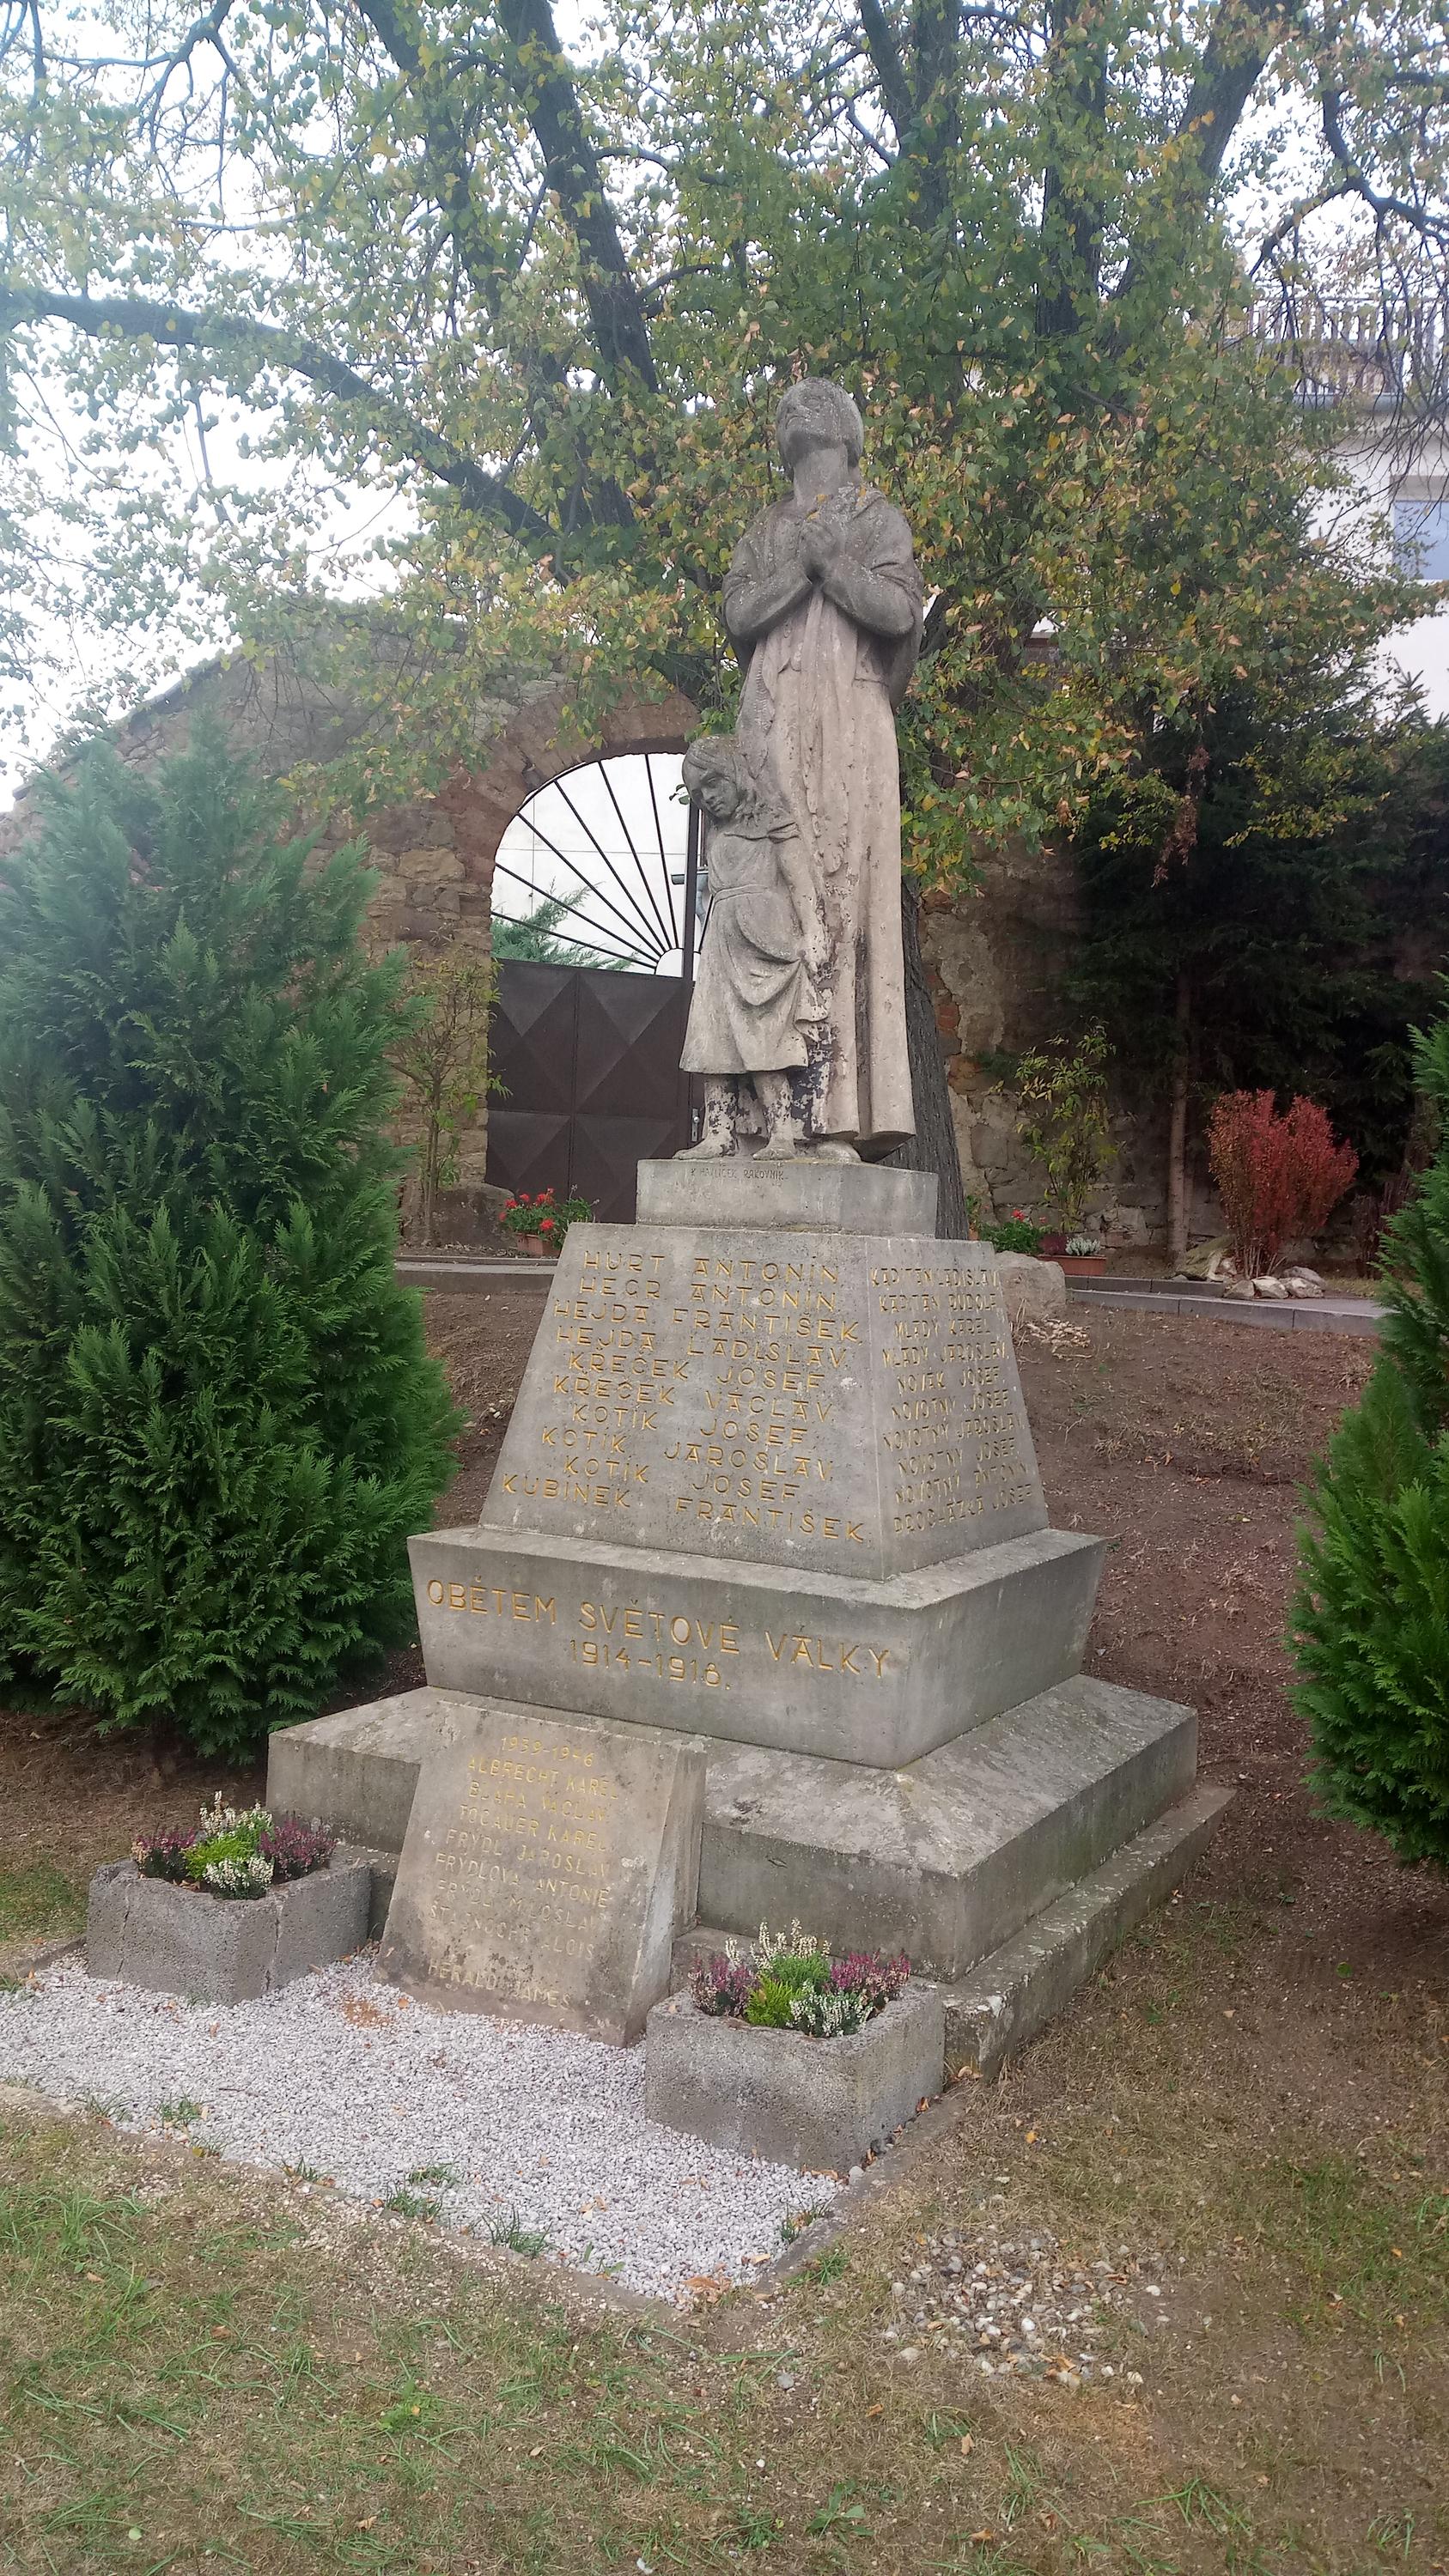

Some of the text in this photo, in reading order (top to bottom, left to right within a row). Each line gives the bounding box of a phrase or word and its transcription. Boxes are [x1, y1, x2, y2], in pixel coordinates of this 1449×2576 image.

[583, 1250, 666, 1273] HURT
[553, 1299, 649, 1324] HEJDA
[557, 1325, 656, 1352] HEJDA
[569, 1346, 690, 1381] KŘEČEK
[552, 1370, 677, 1406] KŘEČEK
[572, 1403, 658, 1430] KOTÍK
[541, 1425, 628, 1454] KOTÍK
[563, 1455, 649, 1484] KOTÍK
[427, 1575, 890, 1679] OBĚTEM SVĚTOVÉ VÁLKY
[468, 1757, 619, 1800] ALBRECHT KAREL
